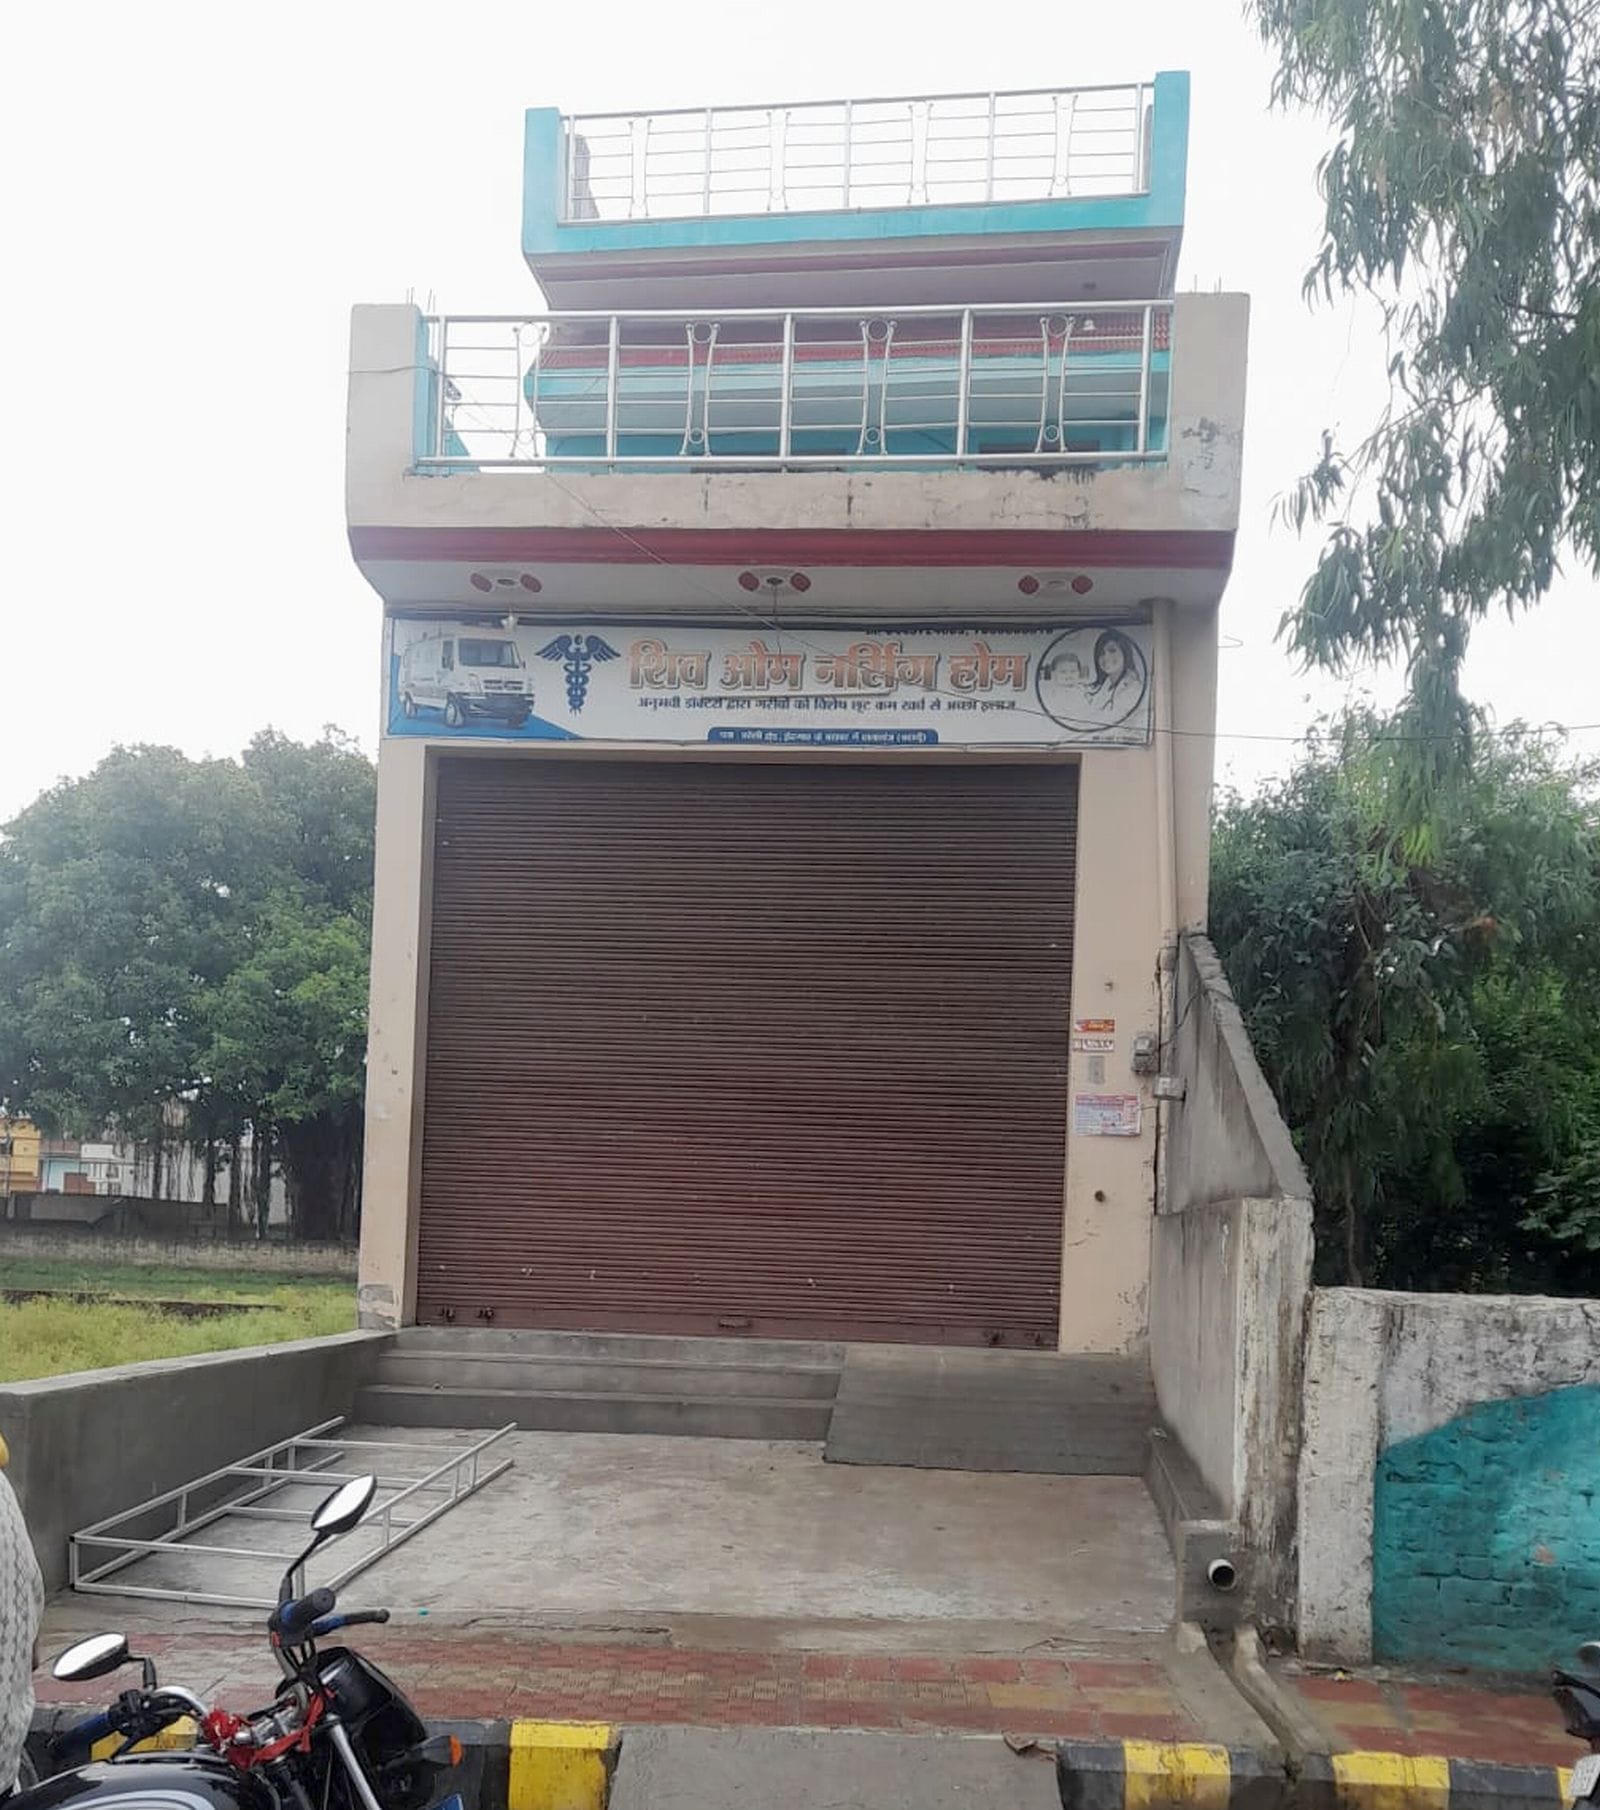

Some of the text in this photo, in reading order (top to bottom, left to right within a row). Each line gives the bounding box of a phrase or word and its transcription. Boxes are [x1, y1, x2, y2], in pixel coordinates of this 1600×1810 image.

[628, 638, 710, 690] शिव
[719, 638, 806, 691] ओम
[947, 640, 1030, 692] होम
